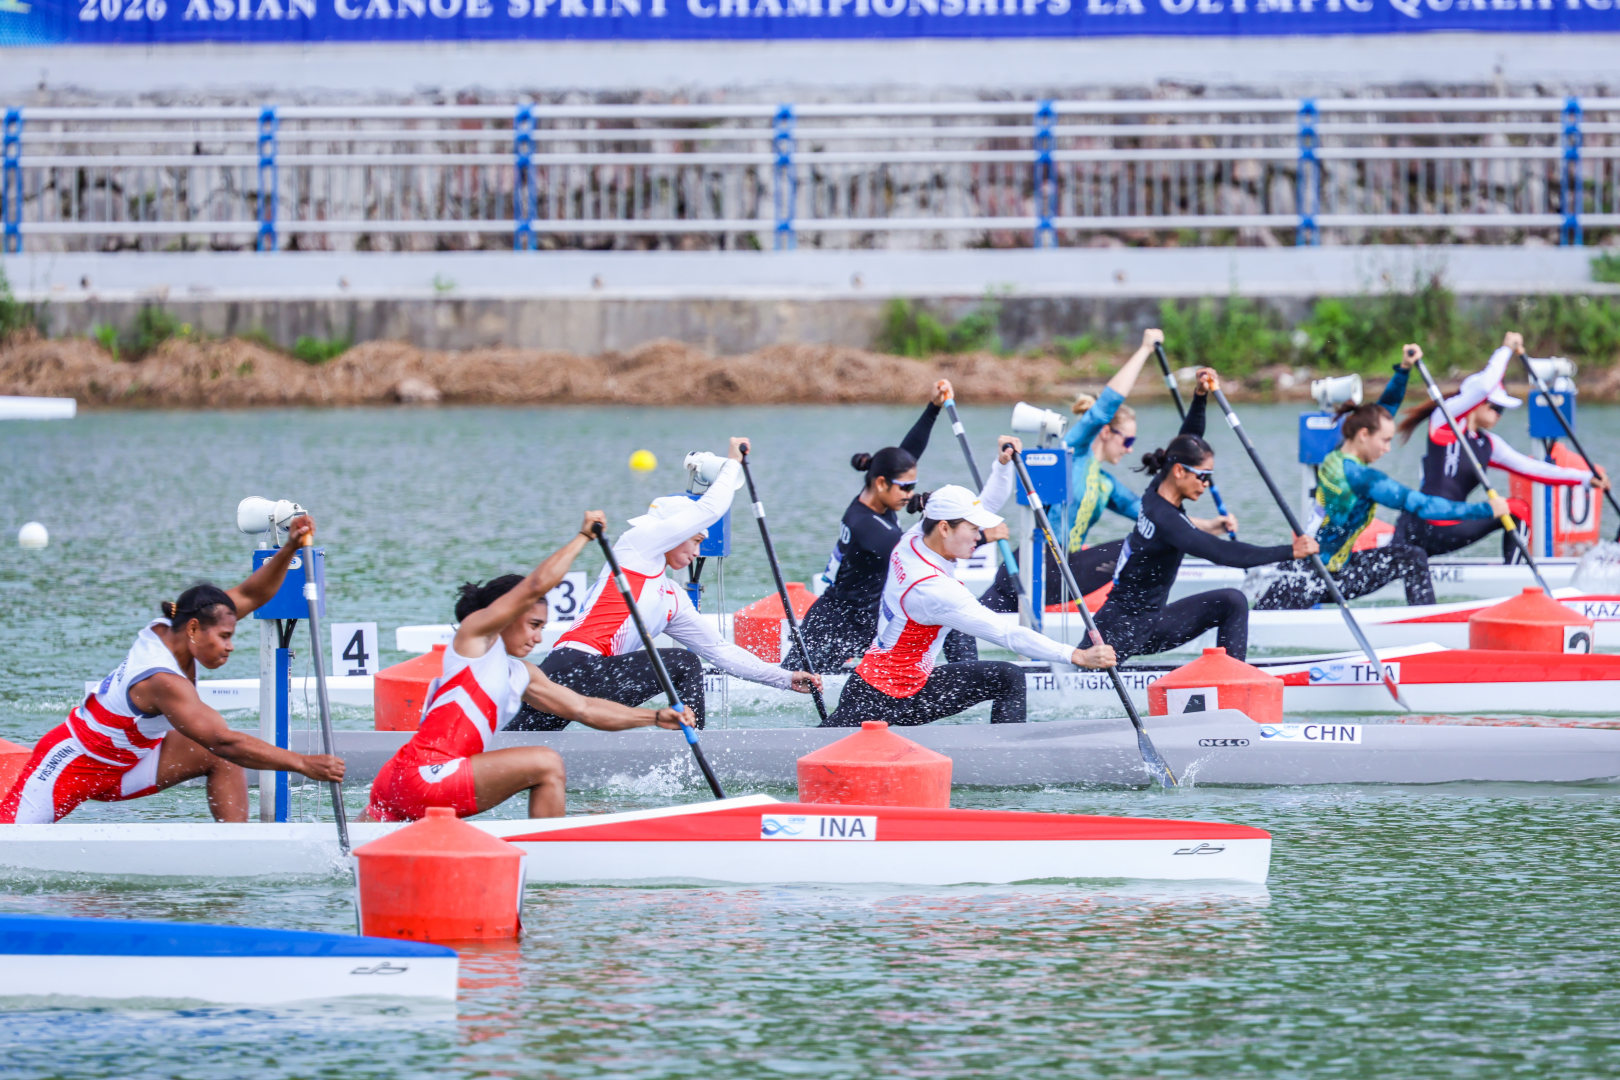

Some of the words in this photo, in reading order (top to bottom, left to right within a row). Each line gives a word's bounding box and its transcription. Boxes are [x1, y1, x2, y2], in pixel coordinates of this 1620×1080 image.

[79, 0, 167, 21] 2026
[183, 0, 317, 21] ASIAN
[334, 0, 494, 20] CANOE
[507, 0, 667, 19] SPRINT
[687, 0, 1071, 18] CHAMPIONSHIPS
[1085, 0, 1145, 16] LA
[1388, 0, 1620, 19] QUALIFIC
[553, 580, 577, 614] 3
[1584, 603, 1620, 617] KAZ
[342, 629, 370, 668] 4
[1351, 665, 1396, 682] THA
[1199, 739, 1249, 747] NELO
[1303, 725, 1355, 741] CHN
[37, 745, 77, 782] INDONESIA
[819, 817, 866, 838] INA
